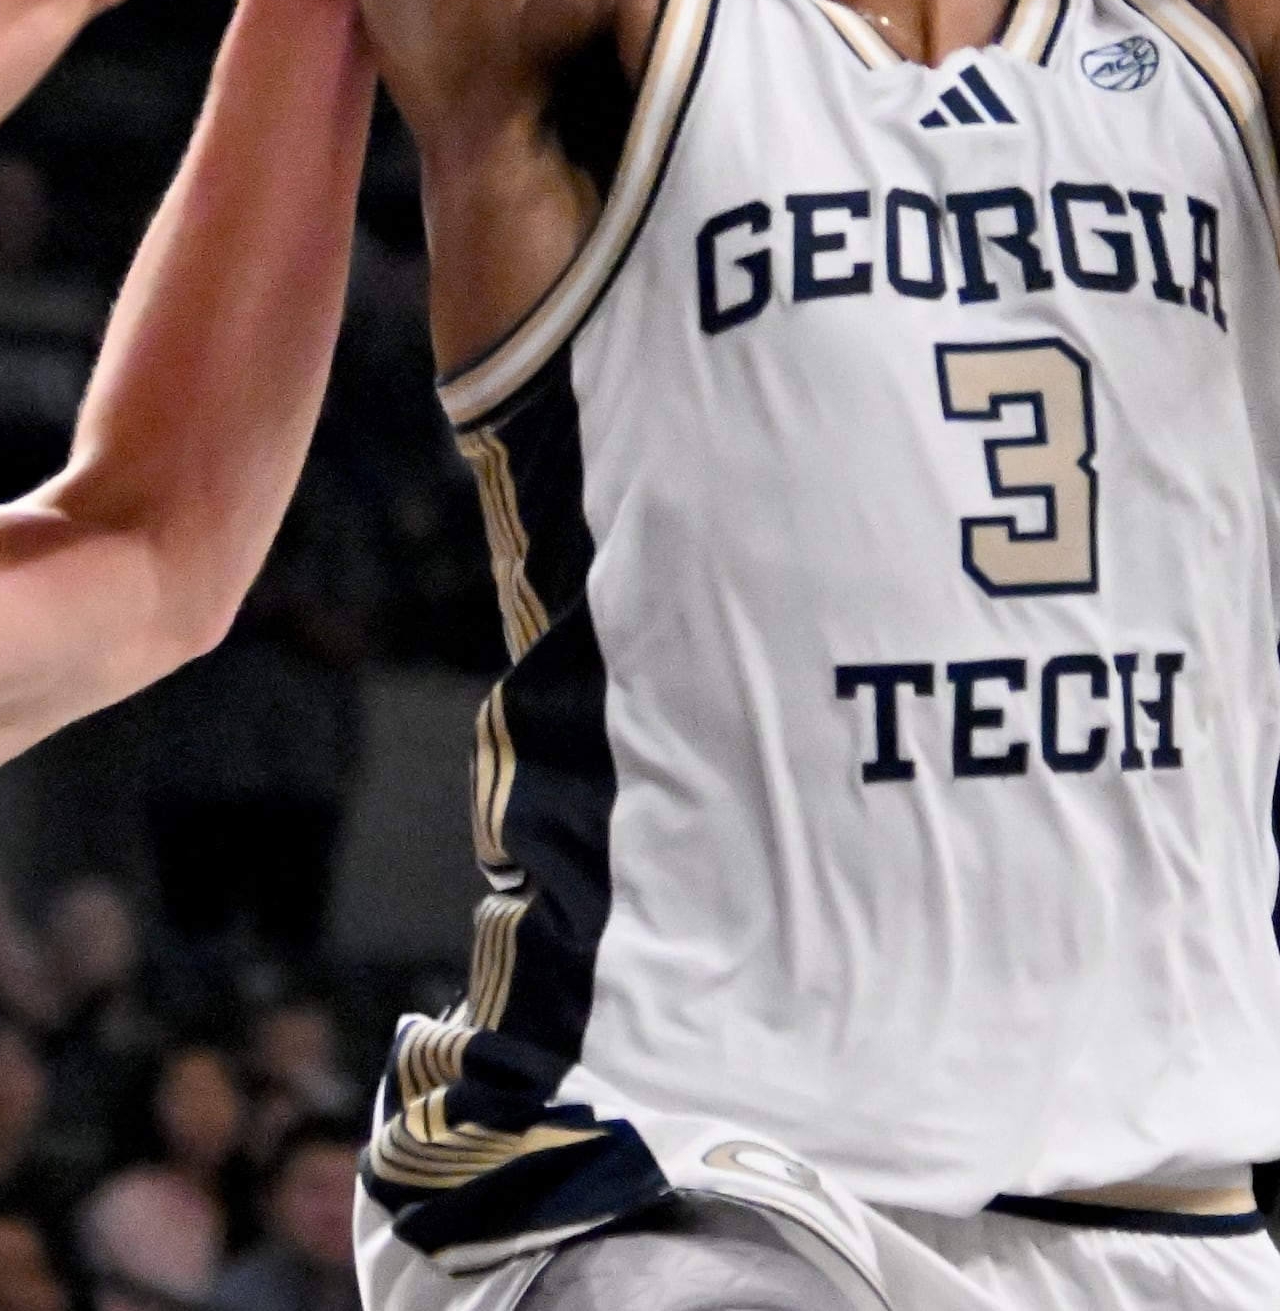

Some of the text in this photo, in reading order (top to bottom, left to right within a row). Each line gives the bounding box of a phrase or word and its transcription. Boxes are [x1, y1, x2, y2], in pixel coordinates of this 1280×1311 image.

[695, 181, 1228, 336] GEORGIA
[934, 337, 1100, 599] 3
[834, 652, 1186, 785] TECH
